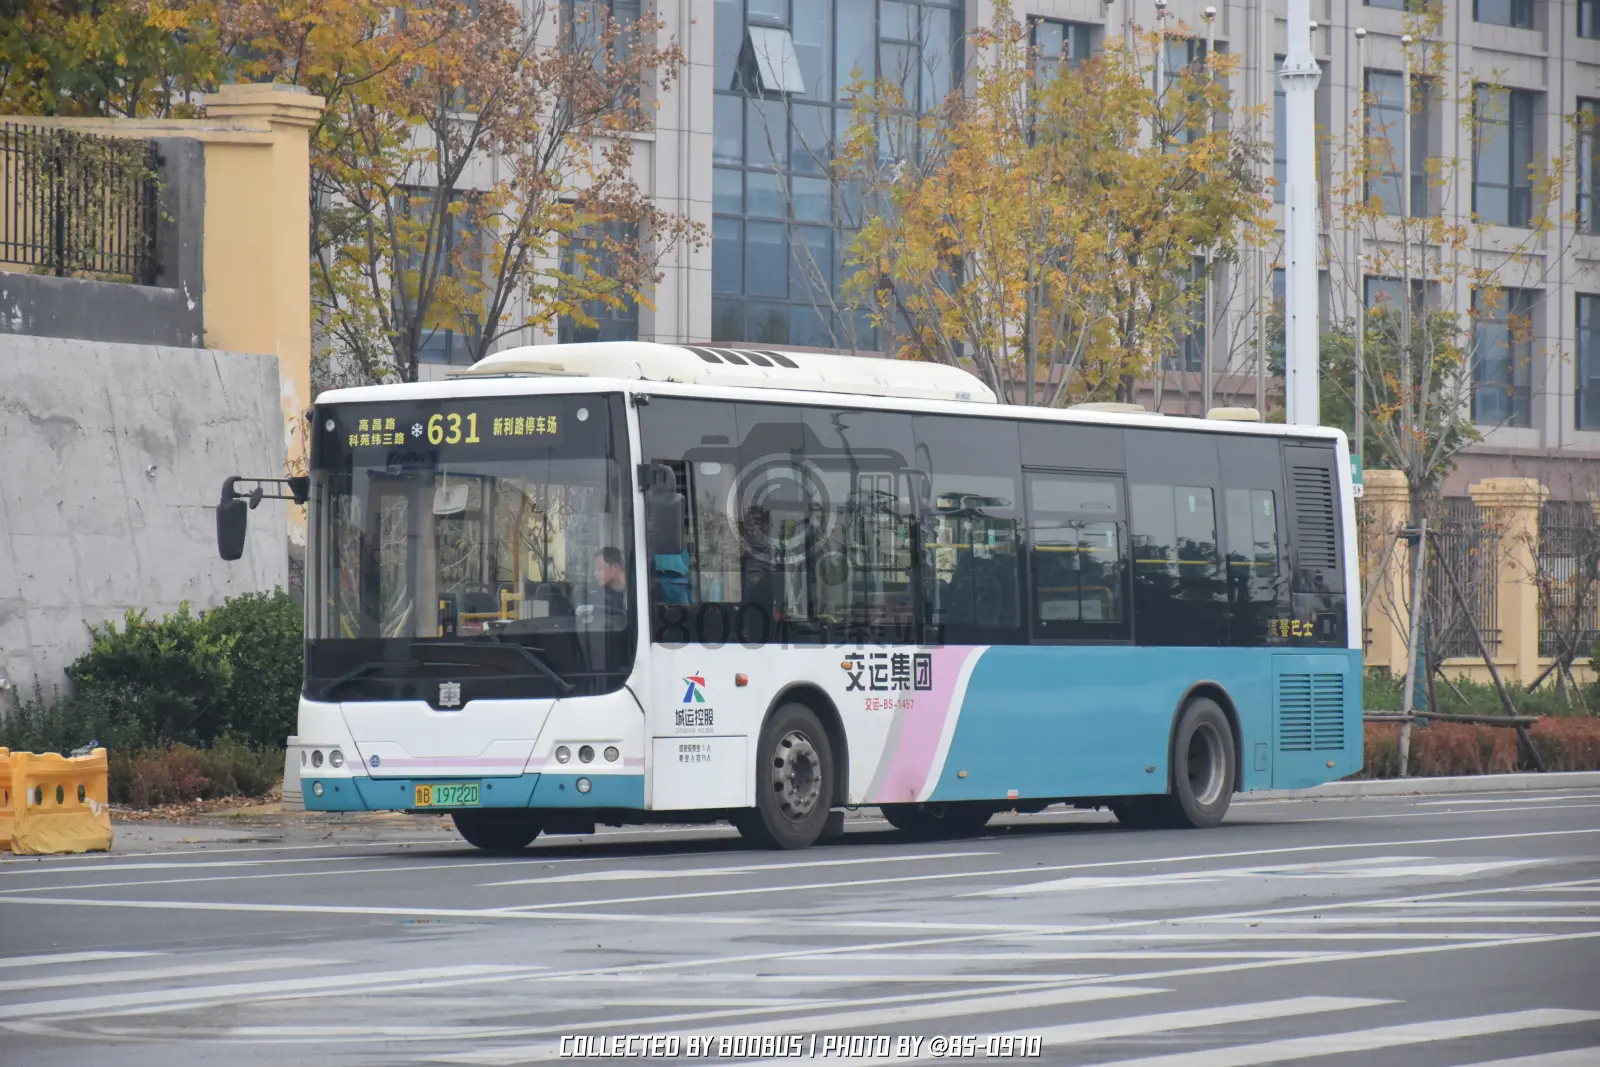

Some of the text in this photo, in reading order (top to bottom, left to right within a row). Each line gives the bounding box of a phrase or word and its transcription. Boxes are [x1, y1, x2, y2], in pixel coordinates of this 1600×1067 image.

[359, 417, 395, 431] 高昌路
[427, 412, 480, 445] 631
[493, 415, 557, 436] 新利路停车场
[348, 432, 404, 446] 科苑纬三路
[844, 653, 932, 691] 交运集团
[675, 708, 714, 726] 城运控股
